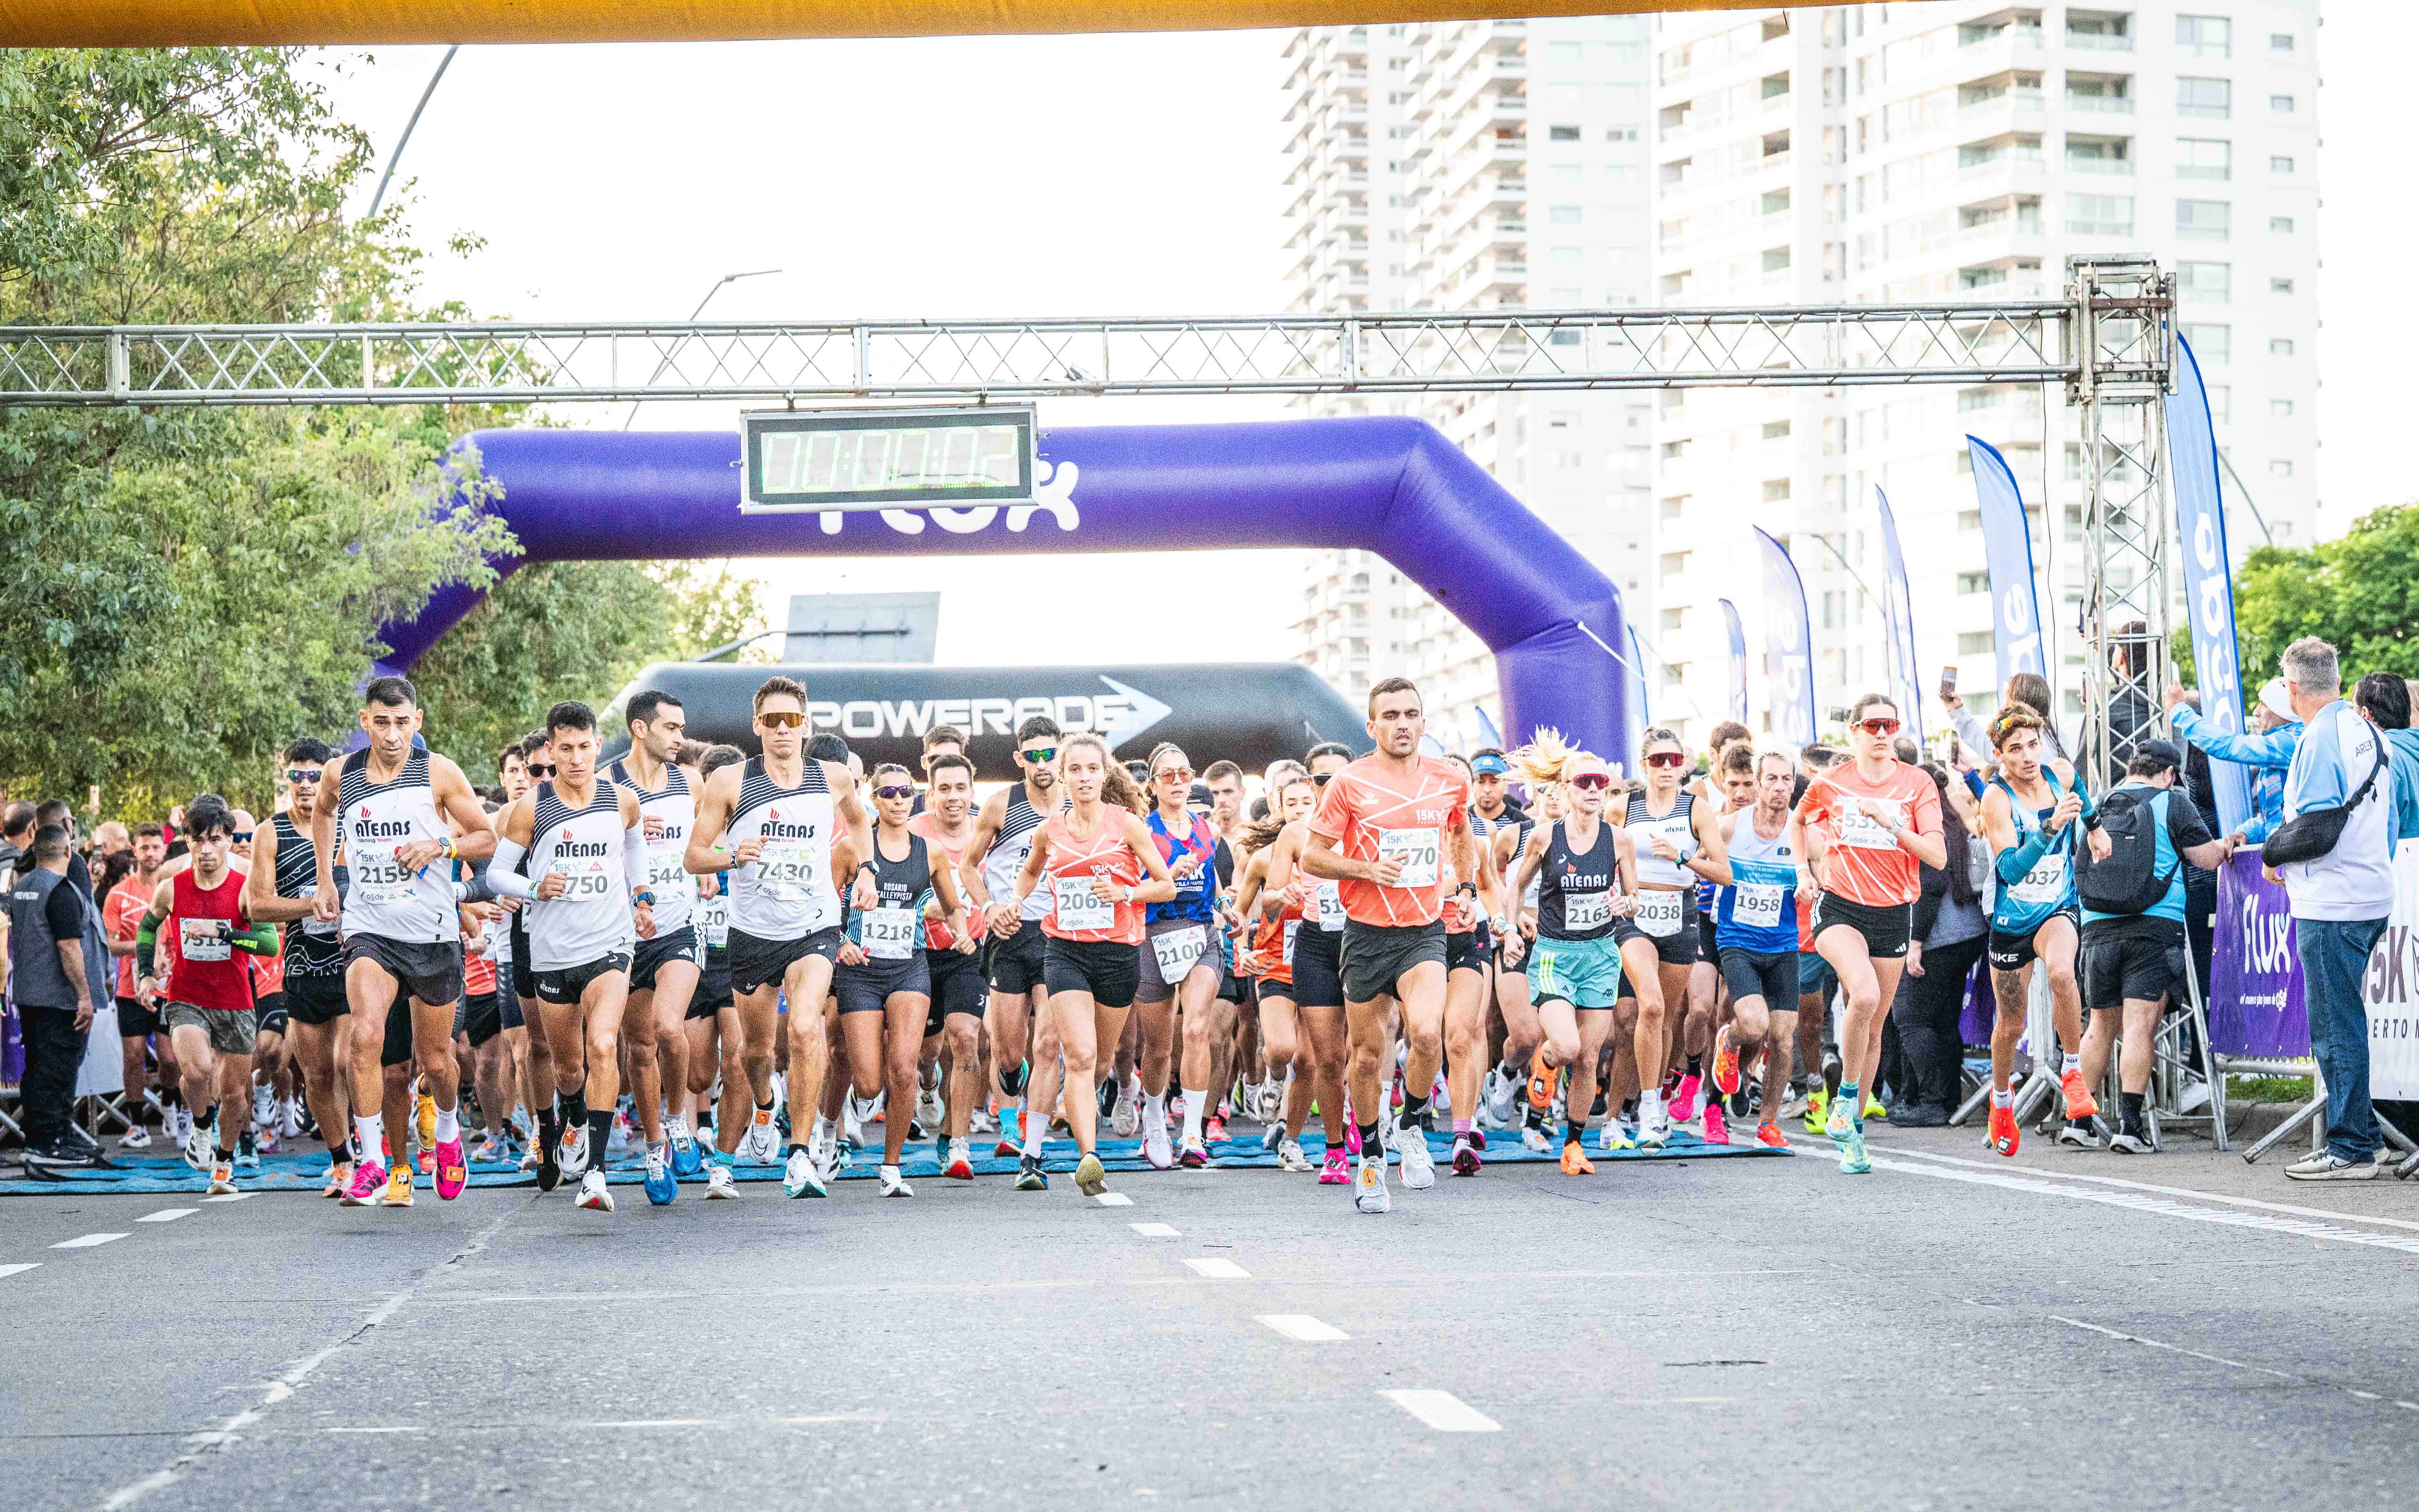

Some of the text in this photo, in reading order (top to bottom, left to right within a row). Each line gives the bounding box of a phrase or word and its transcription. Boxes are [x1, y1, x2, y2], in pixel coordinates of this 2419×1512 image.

[762, 428, 1018, 492] 00:00:02
[807, 695, 1135, 737] POWERADE
[1415, 809, 1436, 821] 15K
[355, 819, 410, 837] ATENAS
[760, 821, 815, 839] ATENAS
[1386, 835, 1402, 844] 15K
[555, 841, 607, 857] ATENAS
[361, 854, 375, 862] 15K
[359, 865, 412, 884] 2159
[555, 863, 571, 872] 15K
[757, 861, 813, 881] 7430
[1090, 864, 1109, 874] 15K
[649, 867, 684, 885] 544
[1560, 873, 1608, 887] ATENAS
[2025, 870, 2061, 885] 037
[566, 875, 608, 895] 750
[884, 882, 907, 892] ROSARIO
[1062, 881, 1076, 890] 15K
[1737, 895, 1780, 912] 1958
[1568, 905, 1610, 924] 2163
[1637, 904, 1680, 920] 2038
[1066, 919, 1084, 927] osde
[864, 923, 913, 940] 1218
[2243, 893, 2291, 974] flux
[1157, 937, 1171, 946] 15K
[1158, 941, 1204, 966] 2100
[1989, 952, 2019, 963] NIKE
[2368, 1018, 2408, 1039] ERTO
